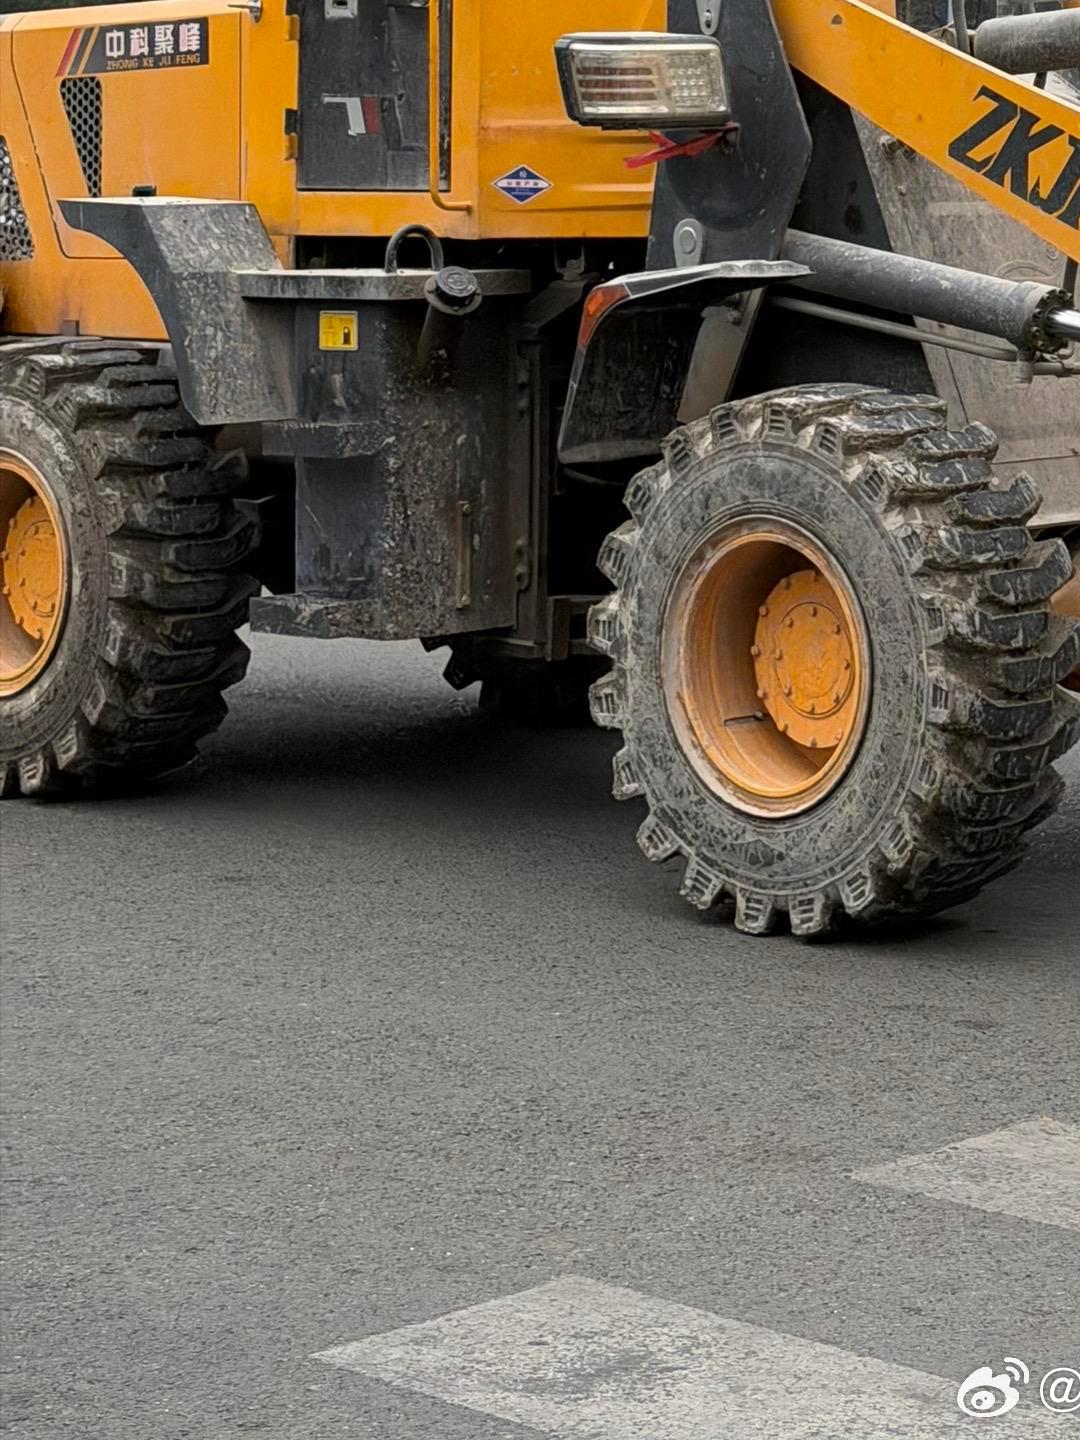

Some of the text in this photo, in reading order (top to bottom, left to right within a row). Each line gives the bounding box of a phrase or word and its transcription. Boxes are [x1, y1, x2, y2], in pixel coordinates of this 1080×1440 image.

[105, 22, 201, 58] 中科聚峰
[106, 53, 201, 70] ZHONG KE JU FENG
